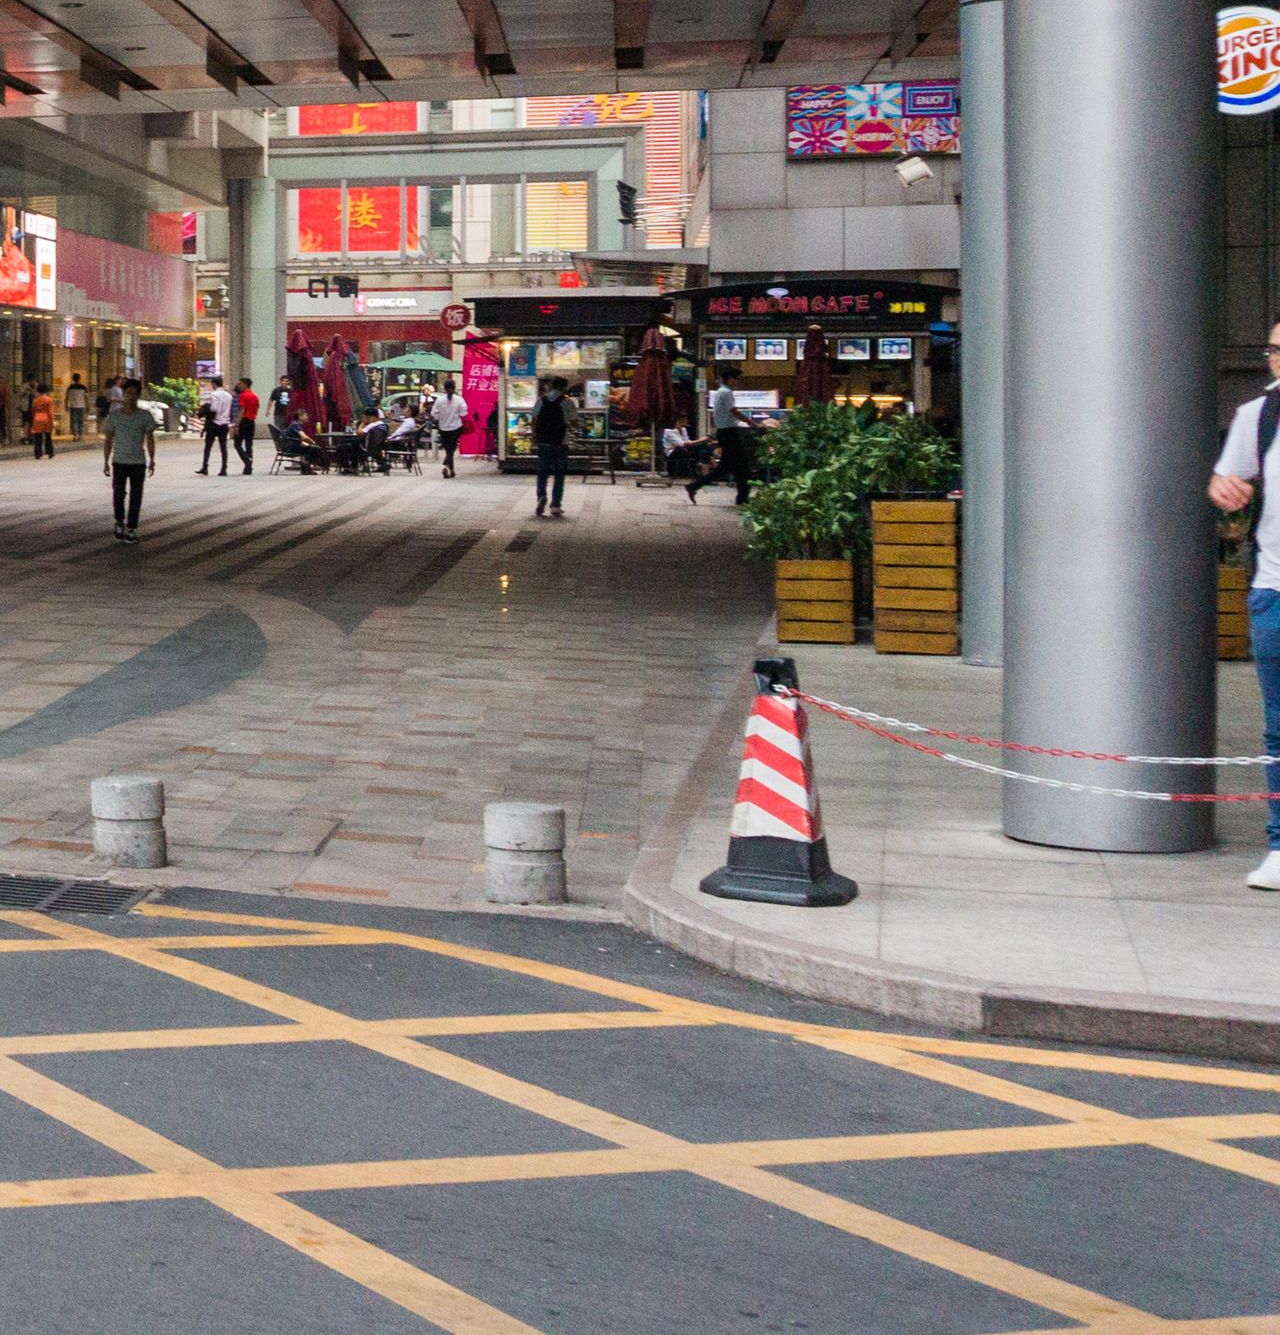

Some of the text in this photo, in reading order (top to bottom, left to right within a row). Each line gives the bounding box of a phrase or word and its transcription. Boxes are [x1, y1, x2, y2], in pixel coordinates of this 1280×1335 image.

[800, 100, 834, 109] HAPPY
[916, 95, 945, 105] ENJOY
[334, 192, 382, 229] 楼
[367, 298, 417, 307] GONG CHA
[708, 295, 870, 314] ICE MOON CAFE
[446, 308, 465, 326] 饭
